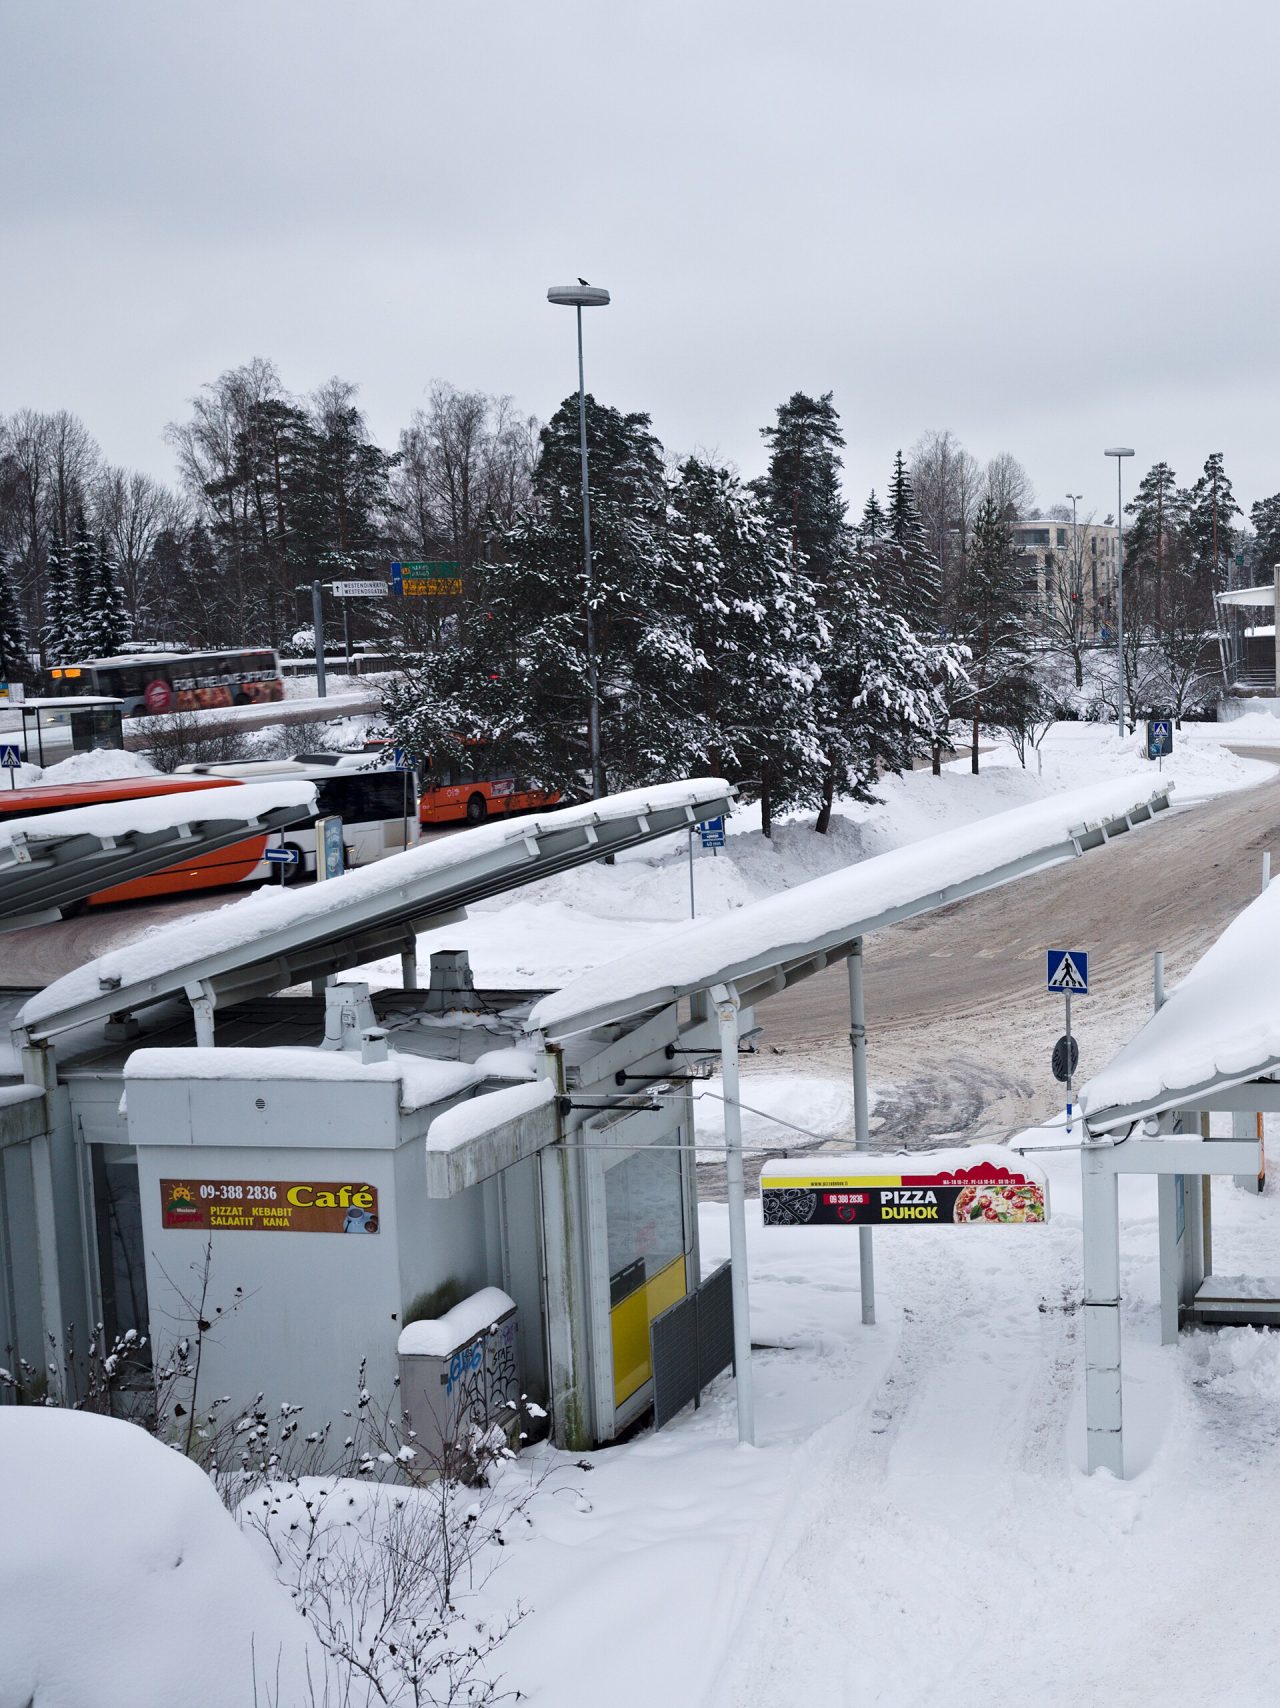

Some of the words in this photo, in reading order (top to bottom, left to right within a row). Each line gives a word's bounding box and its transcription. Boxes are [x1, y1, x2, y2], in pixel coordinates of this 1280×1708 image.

[199, 1185, 243, 1199] 09-388
[246, 1186, 277, 1200] 2836
[286, 1184, 374, 1209] Café
[829, 1194, 838, 1203] 09
[838, 1194, 849, 1203] 388
[849, 1194, 864, 1203] 2836
[880, 1191, 938, 1205] PIZZA
[209, 1207, 243, 1216] PIZZAT
[252, 1207, 293, 1216] KEBABIT
[881, 1206, 939, 1220] DUHOK
[210, 1216, 255, 1226] SALAATIT
[262, 1217, 290, 1226] KANA
